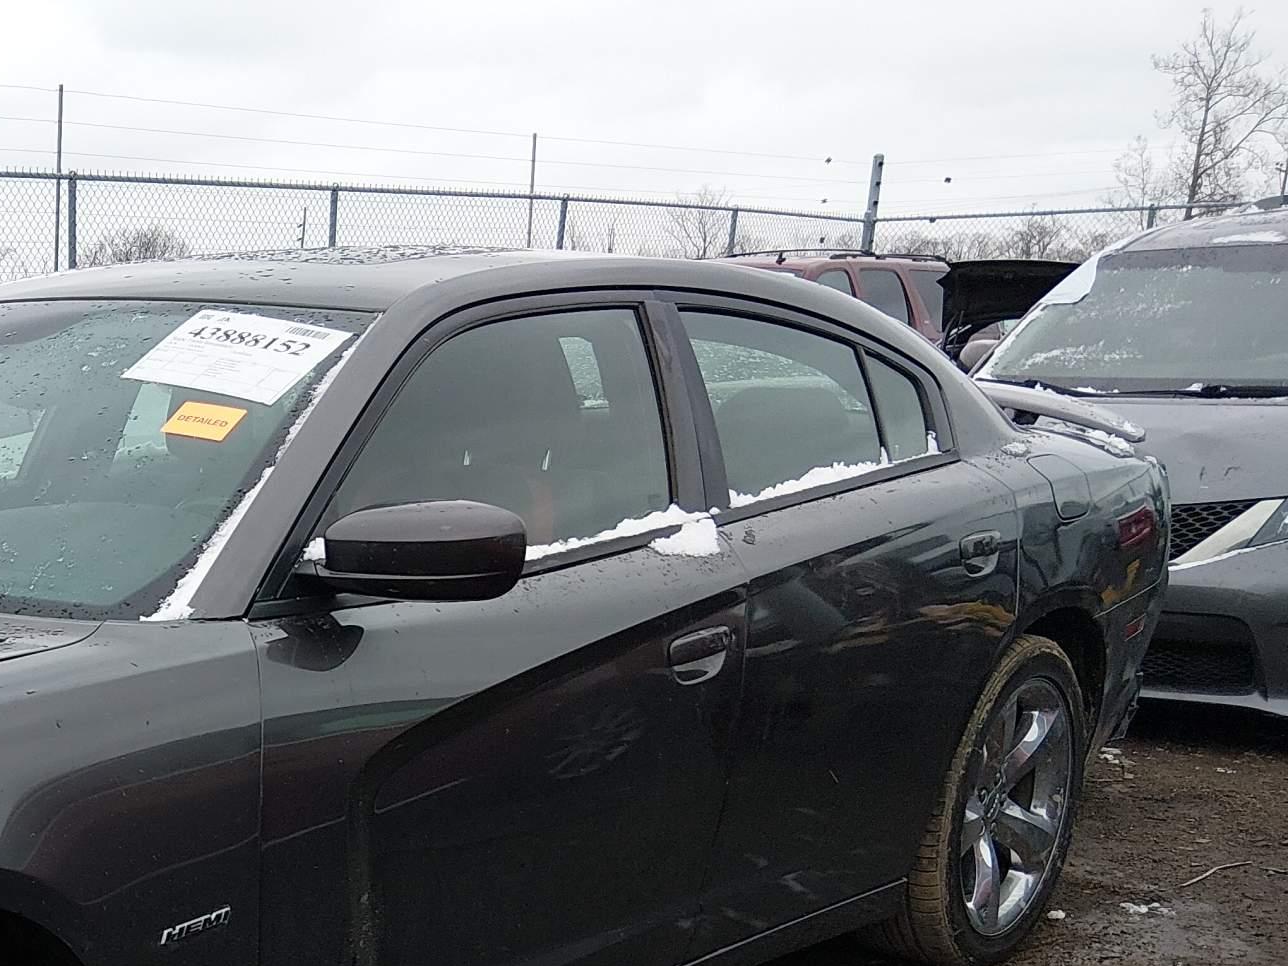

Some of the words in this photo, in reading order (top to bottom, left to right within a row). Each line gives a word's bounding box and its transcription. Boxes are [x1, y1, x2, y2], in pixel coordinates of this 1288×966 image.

[188, 325, 312, 357] 43888152
[176, 413, 229, 429] DETAILED
[159, 904, 232, 945] HEMI
